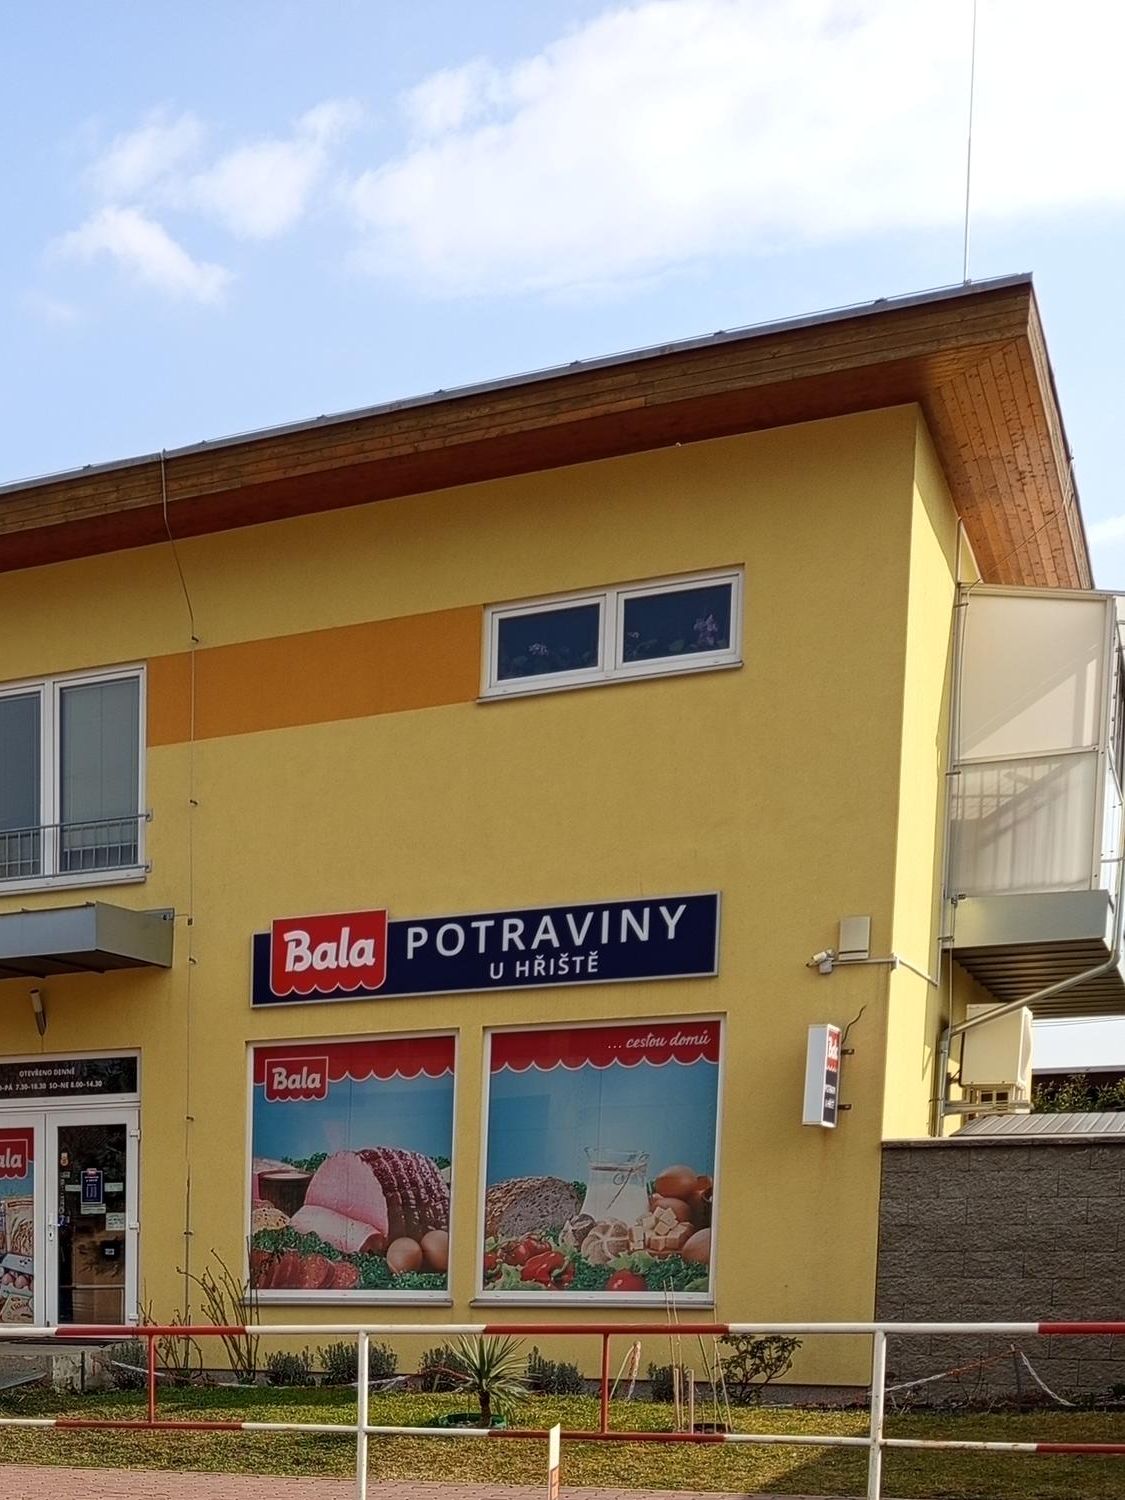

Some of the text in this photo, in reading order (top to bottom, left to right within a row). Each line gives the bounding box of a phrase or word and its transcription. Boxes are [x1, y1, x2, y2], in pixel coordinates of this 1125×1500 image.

[406, 904, 687, 960] POTRAVINY
[283, 926, 376, 973] Bala
[489, 950, 599, 980] U HŘIŠTĚ
[625, 1031, 667, 1049] cestou
[669, 1029, 712, 1047] domů
[18, 1066, 75, 1078] OTEVŘENO DENNĚ
[272, 1066, 322, 1091] Bala
[49, 1081, 69, 1090] SO-NE
